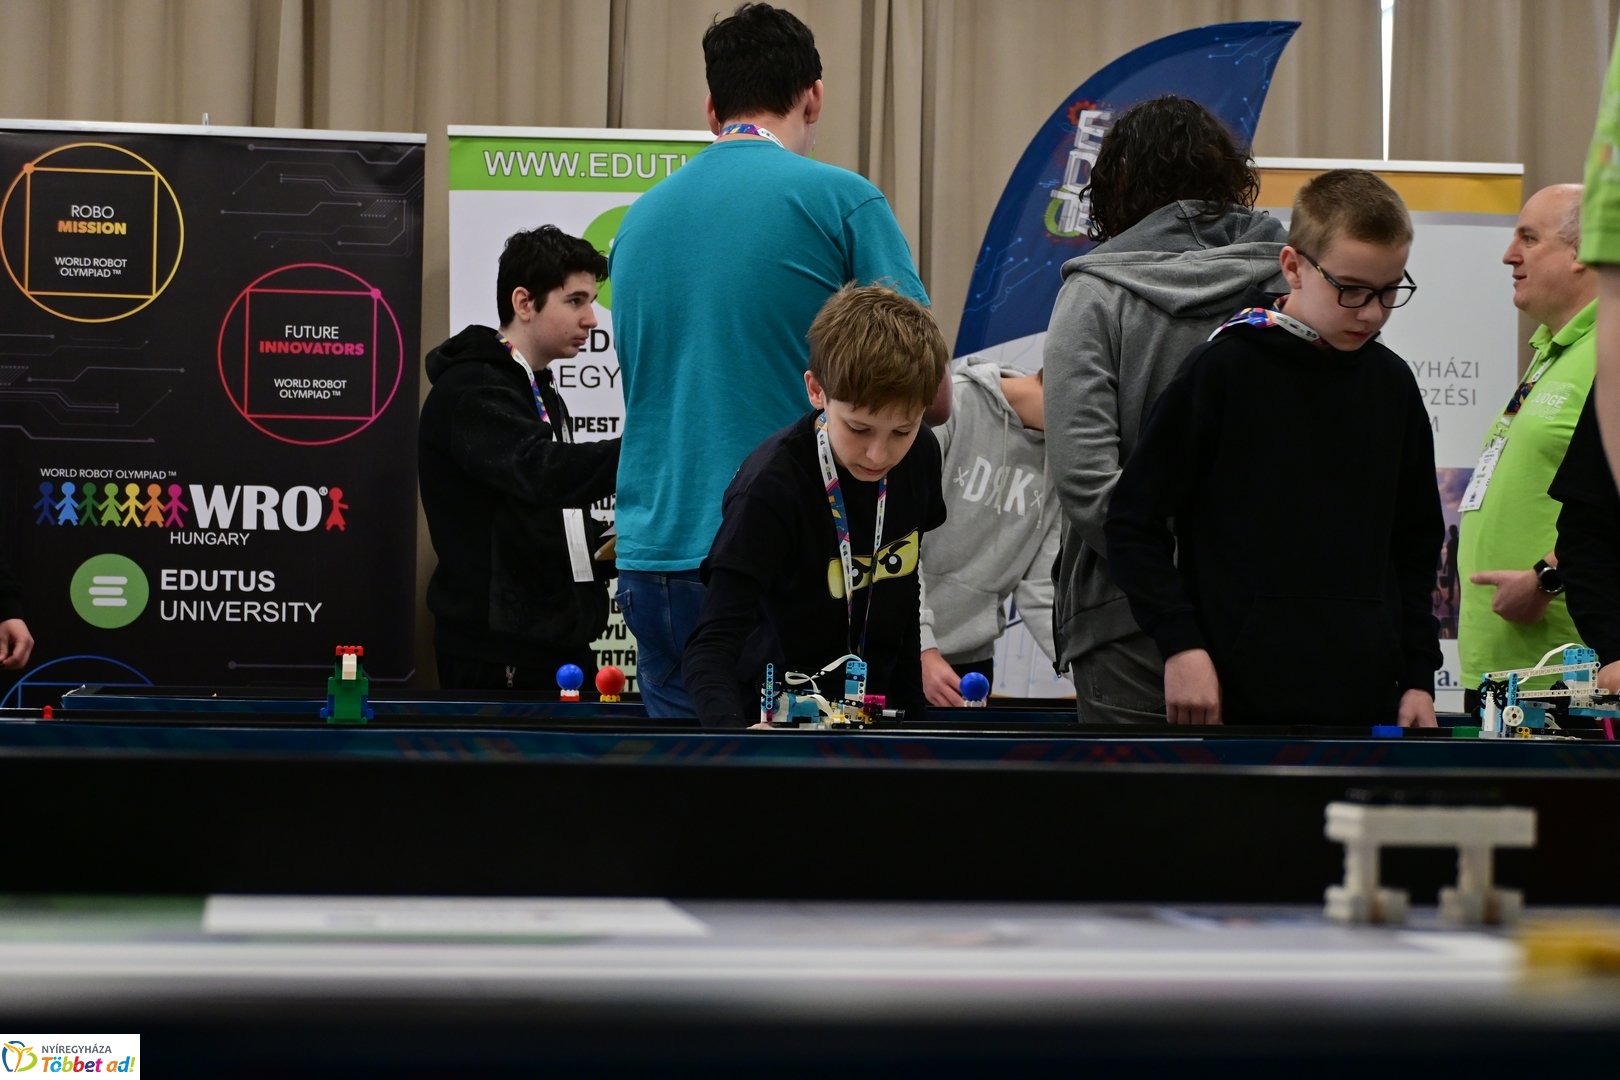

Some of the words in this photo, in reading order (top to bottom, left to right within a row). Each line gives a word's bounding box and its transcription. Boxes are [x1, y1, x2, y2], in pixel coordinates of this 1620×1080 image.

[71, 205, 114, 219] ROBO
[57, 220, 127, 235] MISSION
[55, 256, 91, 268] WORLD
[93, 257, 127, 269] ROBOT
[285, 324, 340, 340] FUTURE
[259, 339, 365, 356] INNOVATORS
[274, 378, 310, 390] WORLD
[312, 378, 347, 390] ROBOT
[40, 468, 77, 478] WORLD
[79, 469, 114, 479] ROBOT
[170, 531, 250, 546] HUNGARY
[161, 569, 275, 593] EDUTUS
[160, 600, 322, 623] UNIVERSITY
